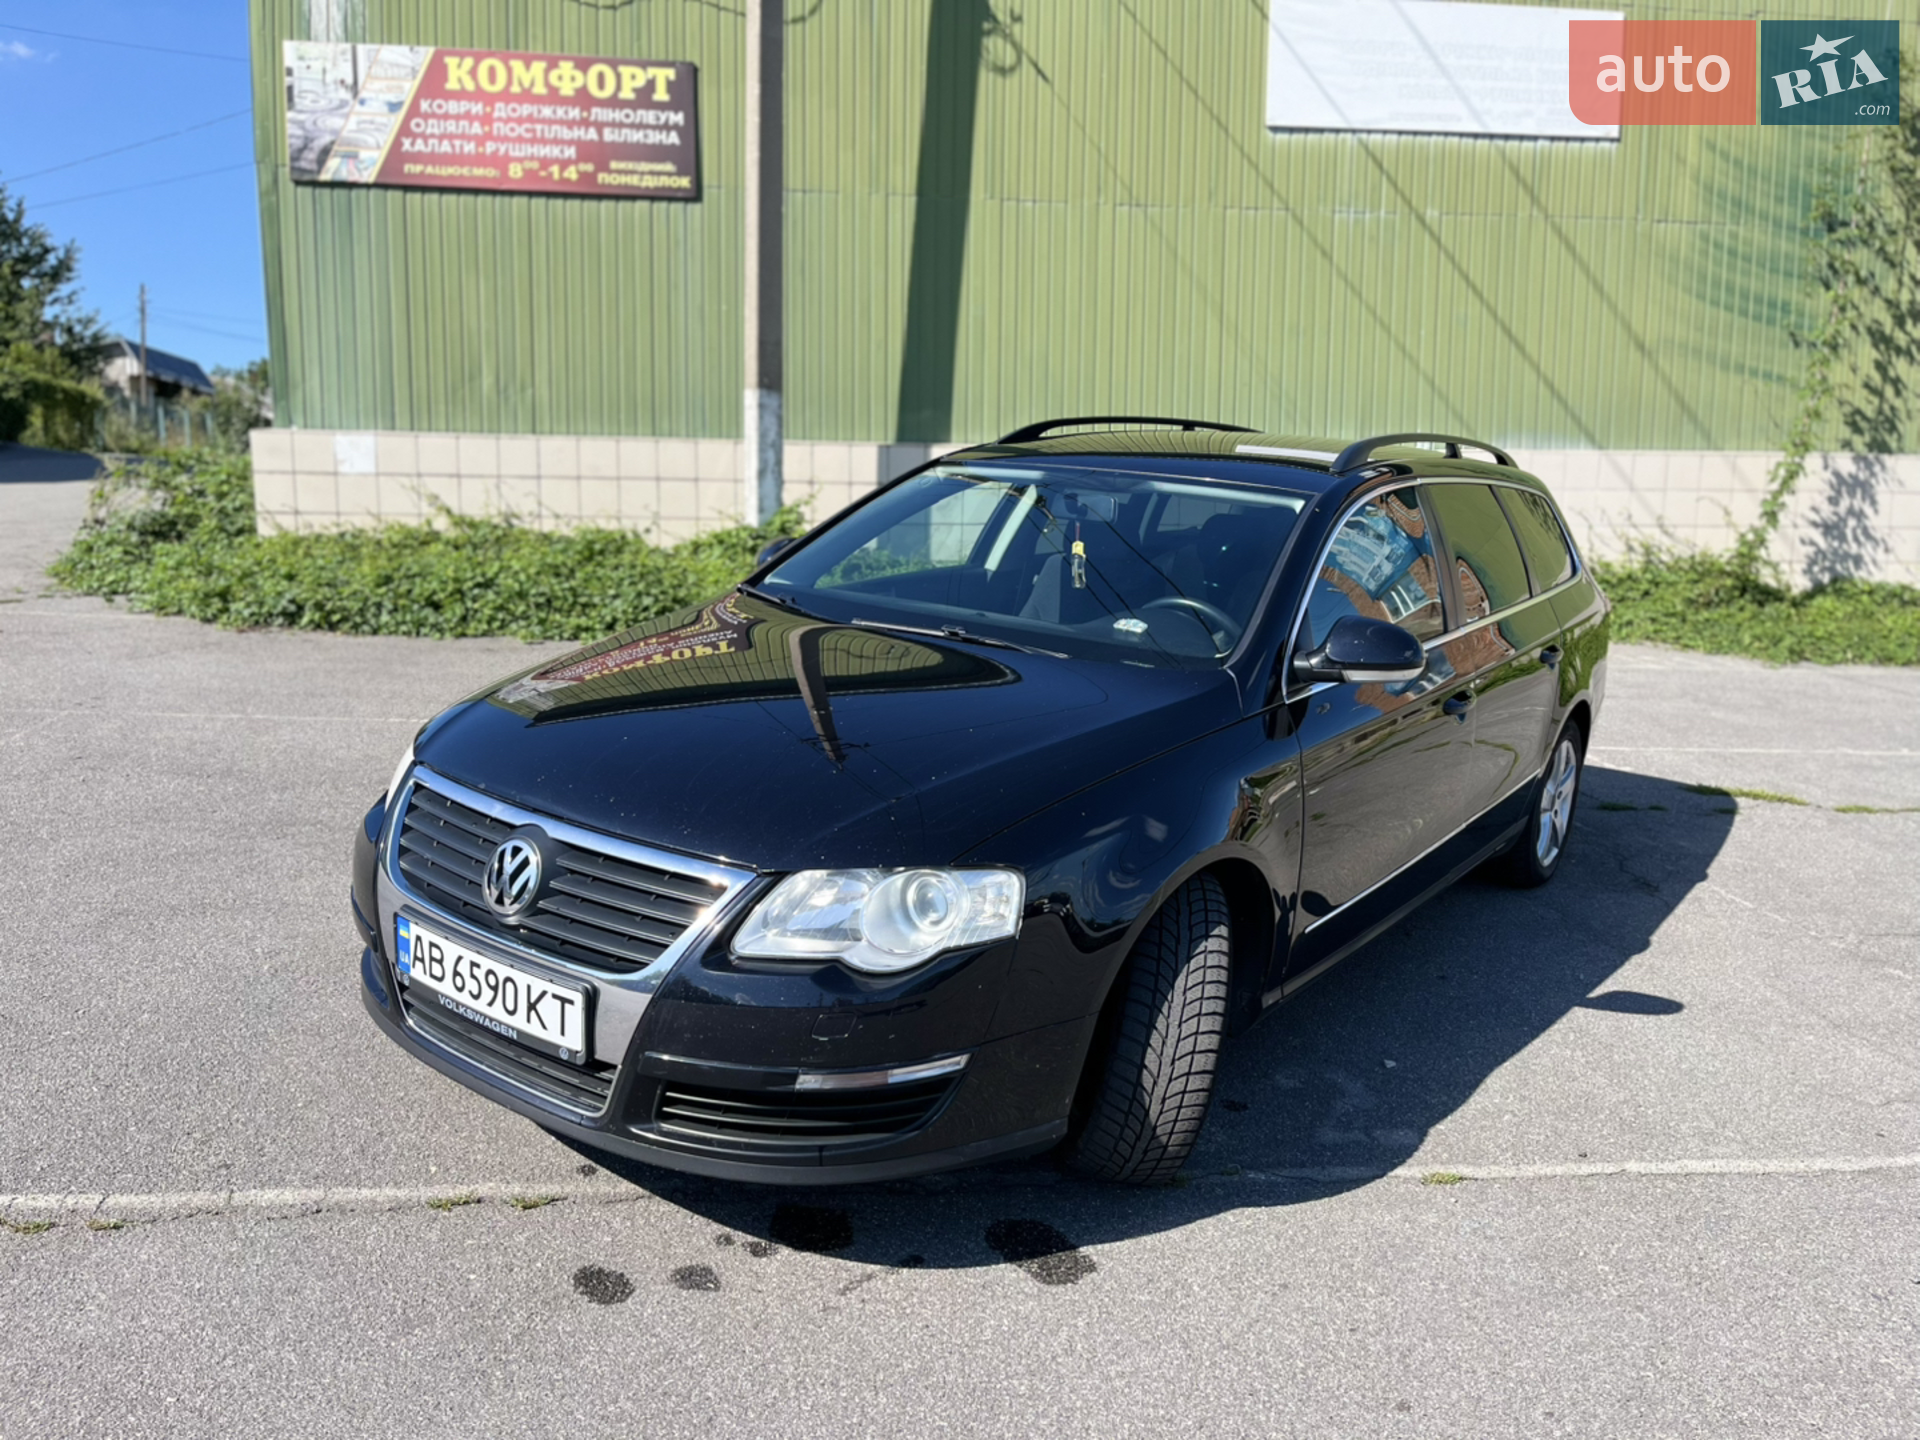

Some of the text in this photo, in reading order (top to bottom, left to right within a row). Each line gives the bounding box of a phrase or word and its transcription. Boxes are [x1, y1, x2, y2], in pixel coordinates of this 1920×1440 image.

[443, 55, 677, 102] КОМФОРТ
[420, 98, 685, 127] КОВРИ ДОРІЖКИ ЛІНОЛЕУМ
[401, 137, 577, 160] ХАЛАТИ РУШНИКИ
[410, 118, 681, 146] ОДІЯЛА ПОСТІЛЬНА БІЛИЗНА
[412, 934, 575, 1037] AB 6590 KT
[438, 994, 517, 1039] VOLKSWAGEN
